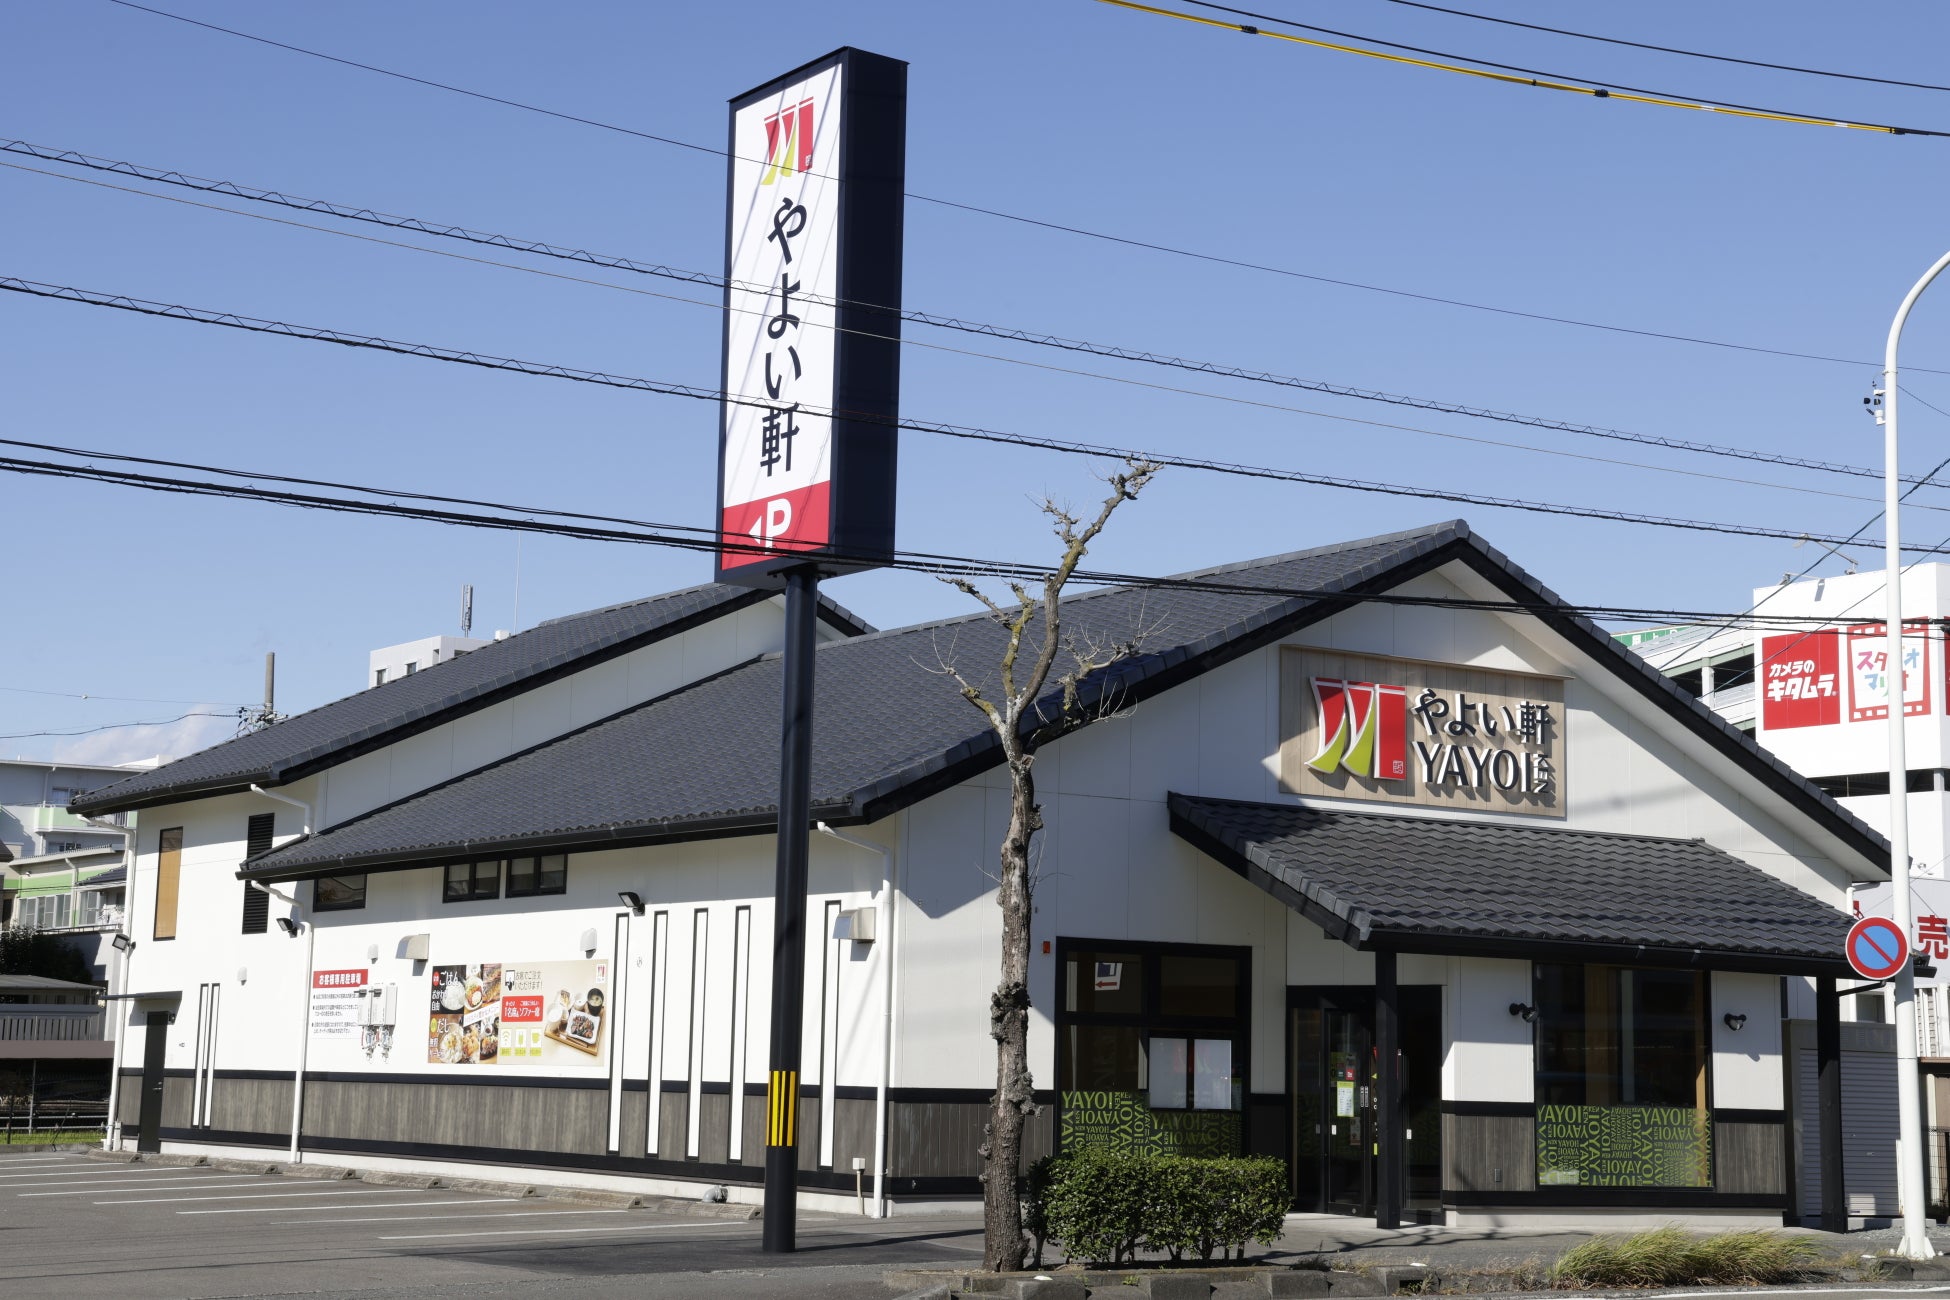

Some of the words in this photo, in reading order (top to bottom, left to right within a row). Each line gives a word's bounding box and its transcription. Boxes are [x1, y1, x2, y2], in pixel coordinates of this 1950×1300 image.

[760, 197, 807, 478] やよい軒
[765, 498, 792, 555] P
[1769, 660, 1815, 678] カメラの
[1856, 648, 1920, 671] スタオ
[1767, 673, 1835, 702] キタムラ
[1411, 687, 1550, 745] やよい軒
[1412, 740, 1532, 793] YAYOI
[1534, 753, 1549, 793] KEN
[1917, 915, 1949, 959] 売
[1062, 1091, 1112, 1109] YAYOI
[1537, 1105, 1582, 1123] YAYOI
[1641, 1107, 1686, 1126] YAYOI
